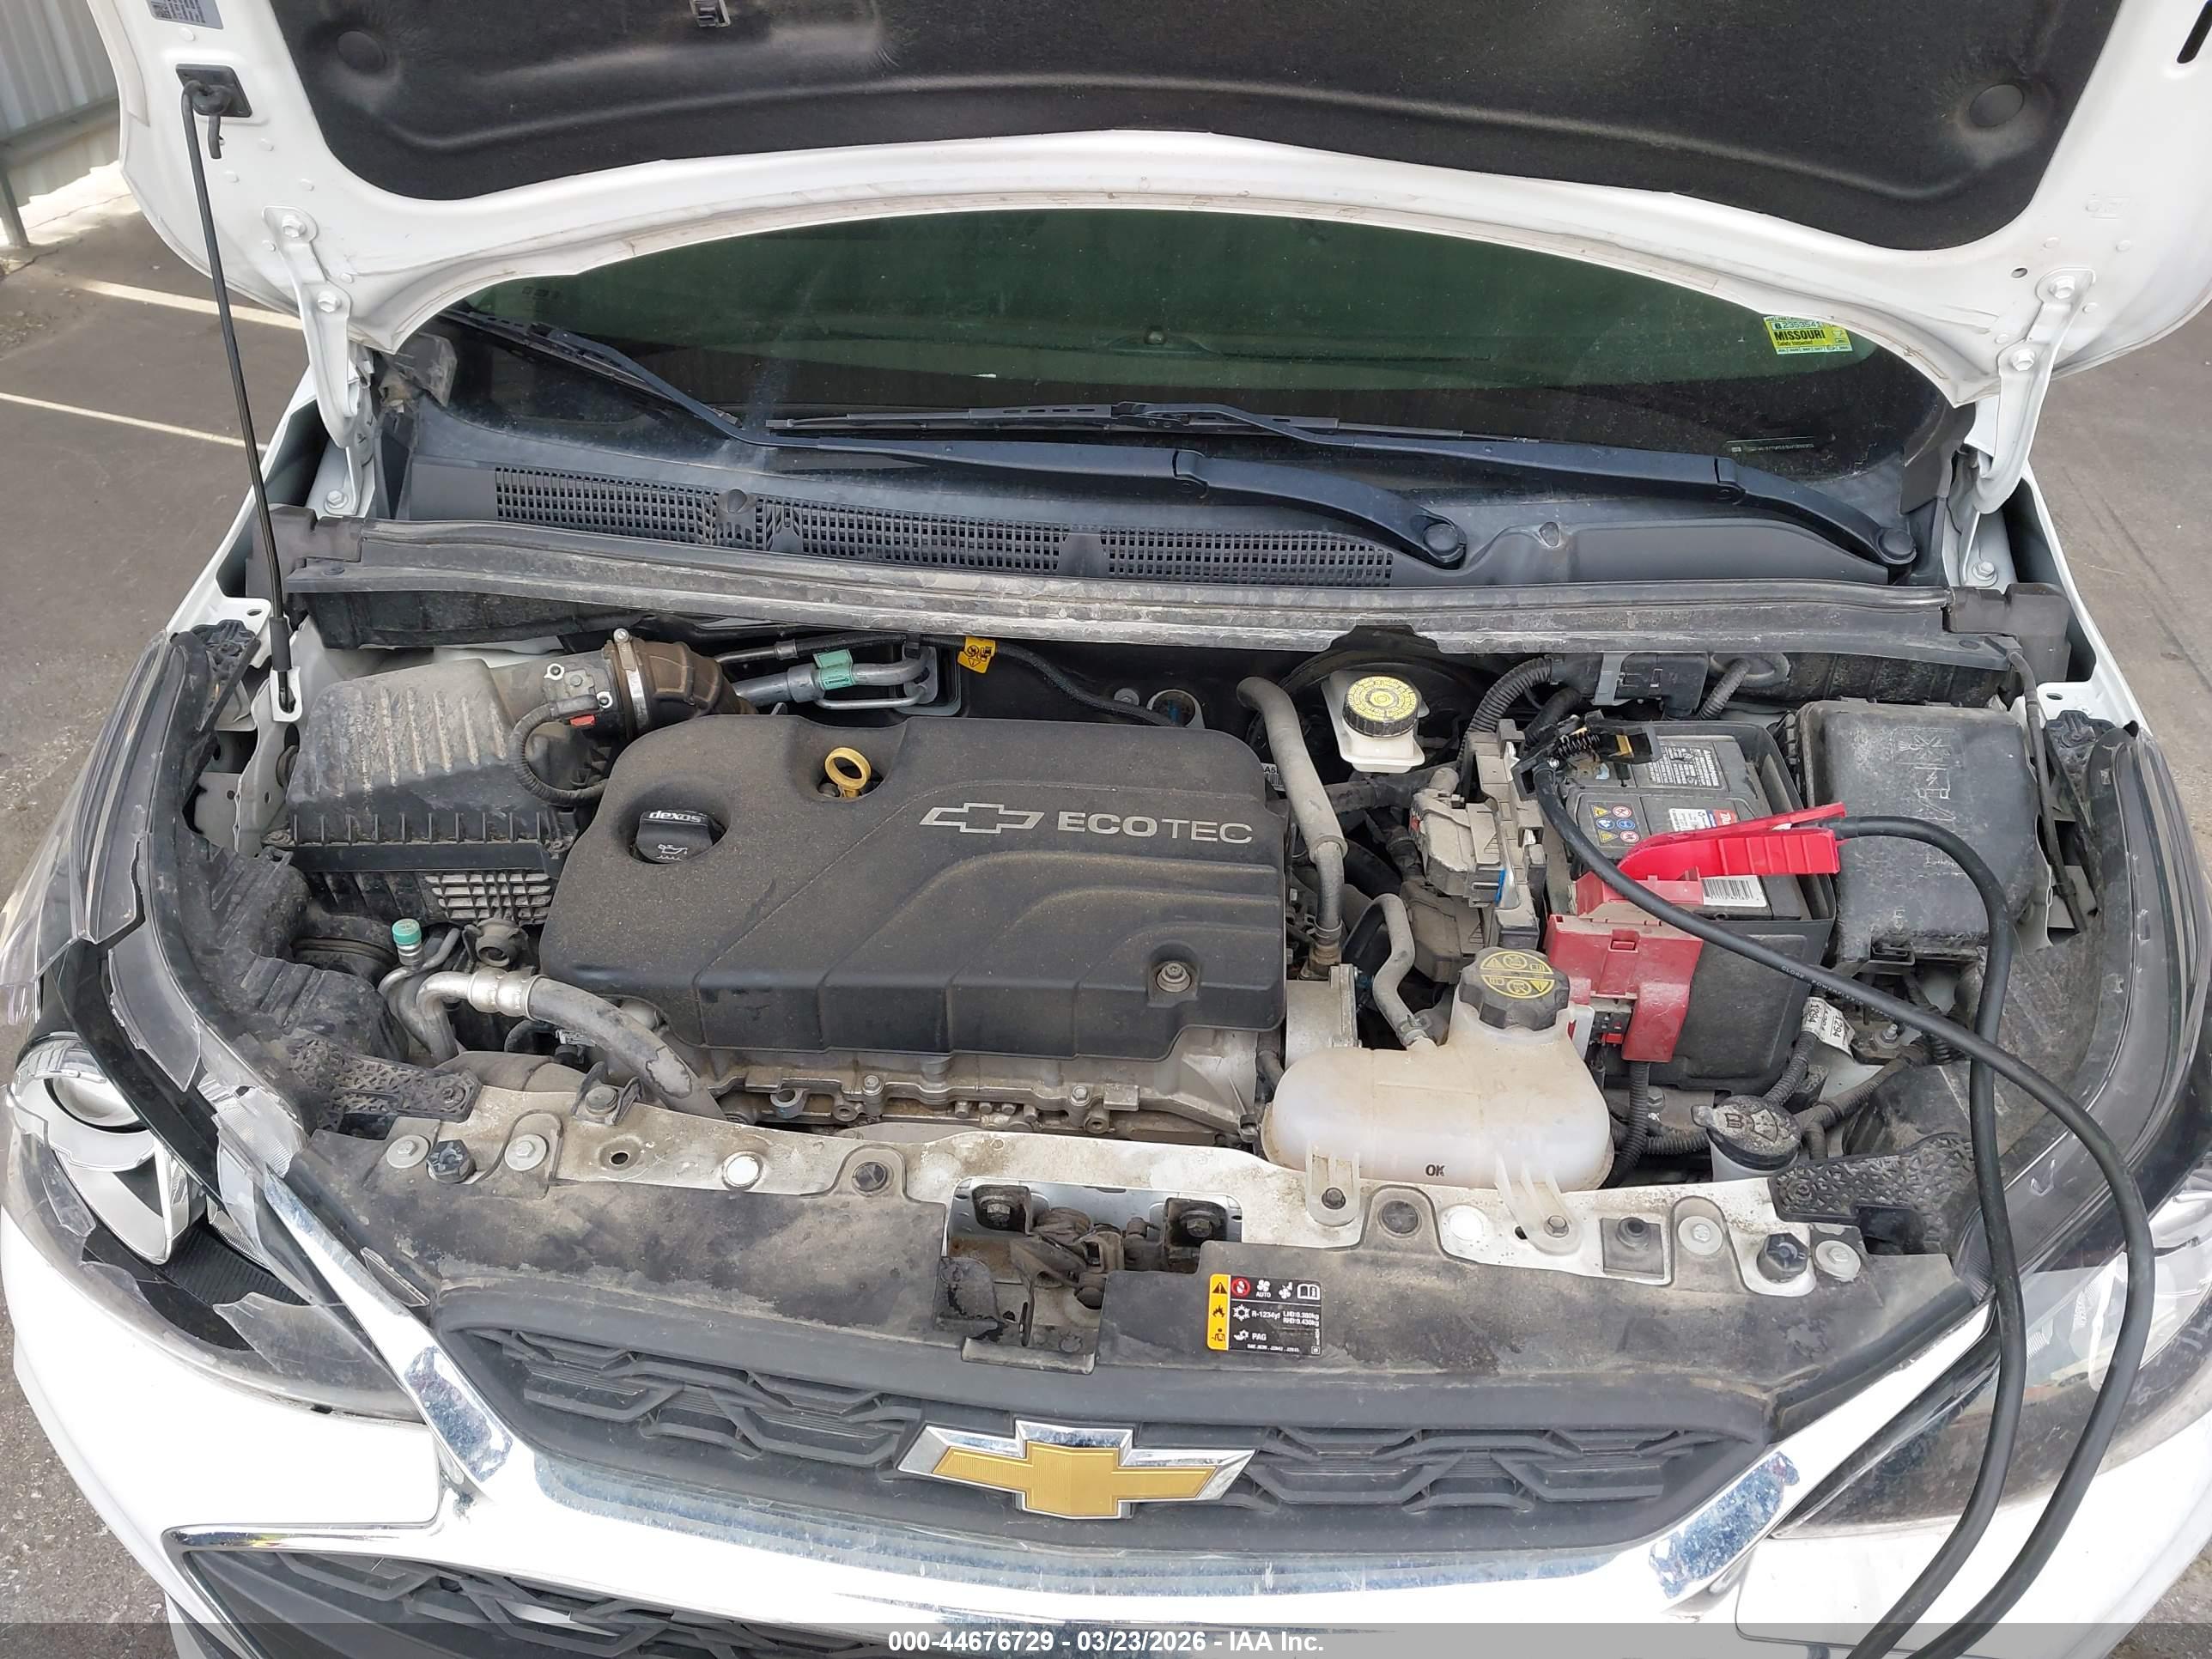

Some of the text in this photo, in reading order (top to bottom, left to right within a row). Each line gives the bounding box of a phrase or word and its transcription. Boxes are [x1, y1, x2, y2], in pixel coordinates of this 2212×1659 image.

[1774, 330, 1826, 341] MISSOURI
[648, 810, 702, 823] dexos
[1057, 811, 1254, 844] ECOTEC
[1832, 1015, 1843, 1038] 1294
[1425, 1164, 1445, 1176] OK
[1251, 1310, 1280, 1320] R-1234yf
